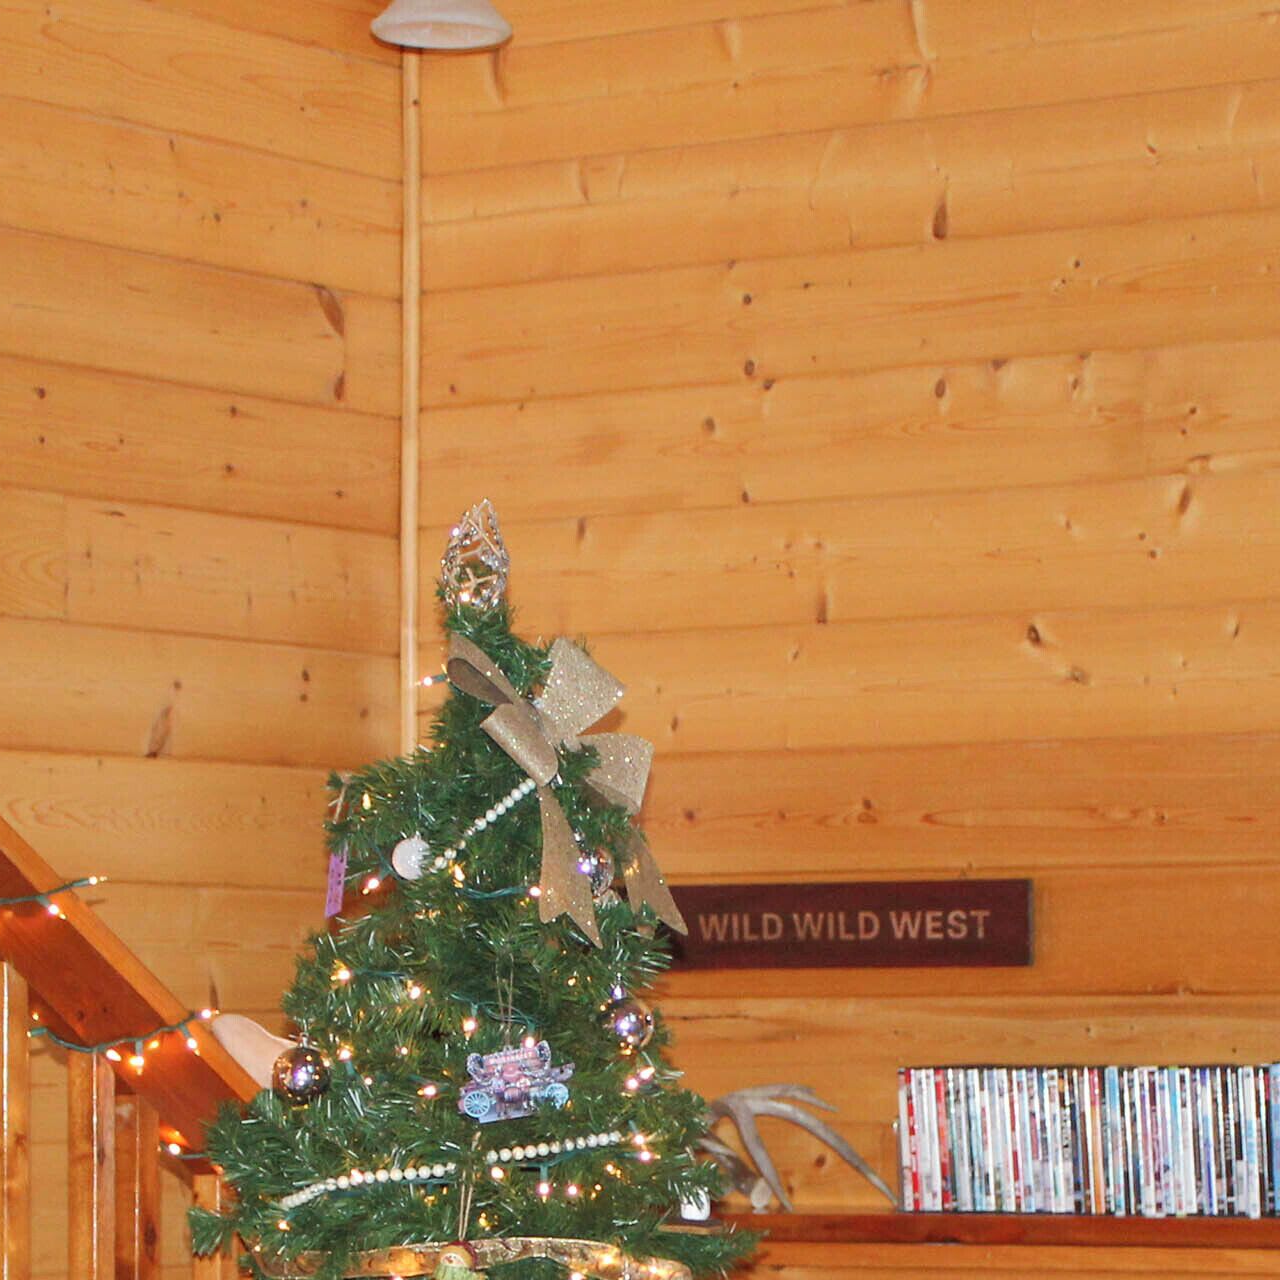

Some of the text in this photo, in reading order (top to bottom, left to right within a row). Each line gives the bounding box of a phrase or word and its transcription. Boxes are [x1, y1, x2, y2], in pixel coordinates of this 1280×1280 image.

[698, 909, 990, 942] WILD WILD WEST
